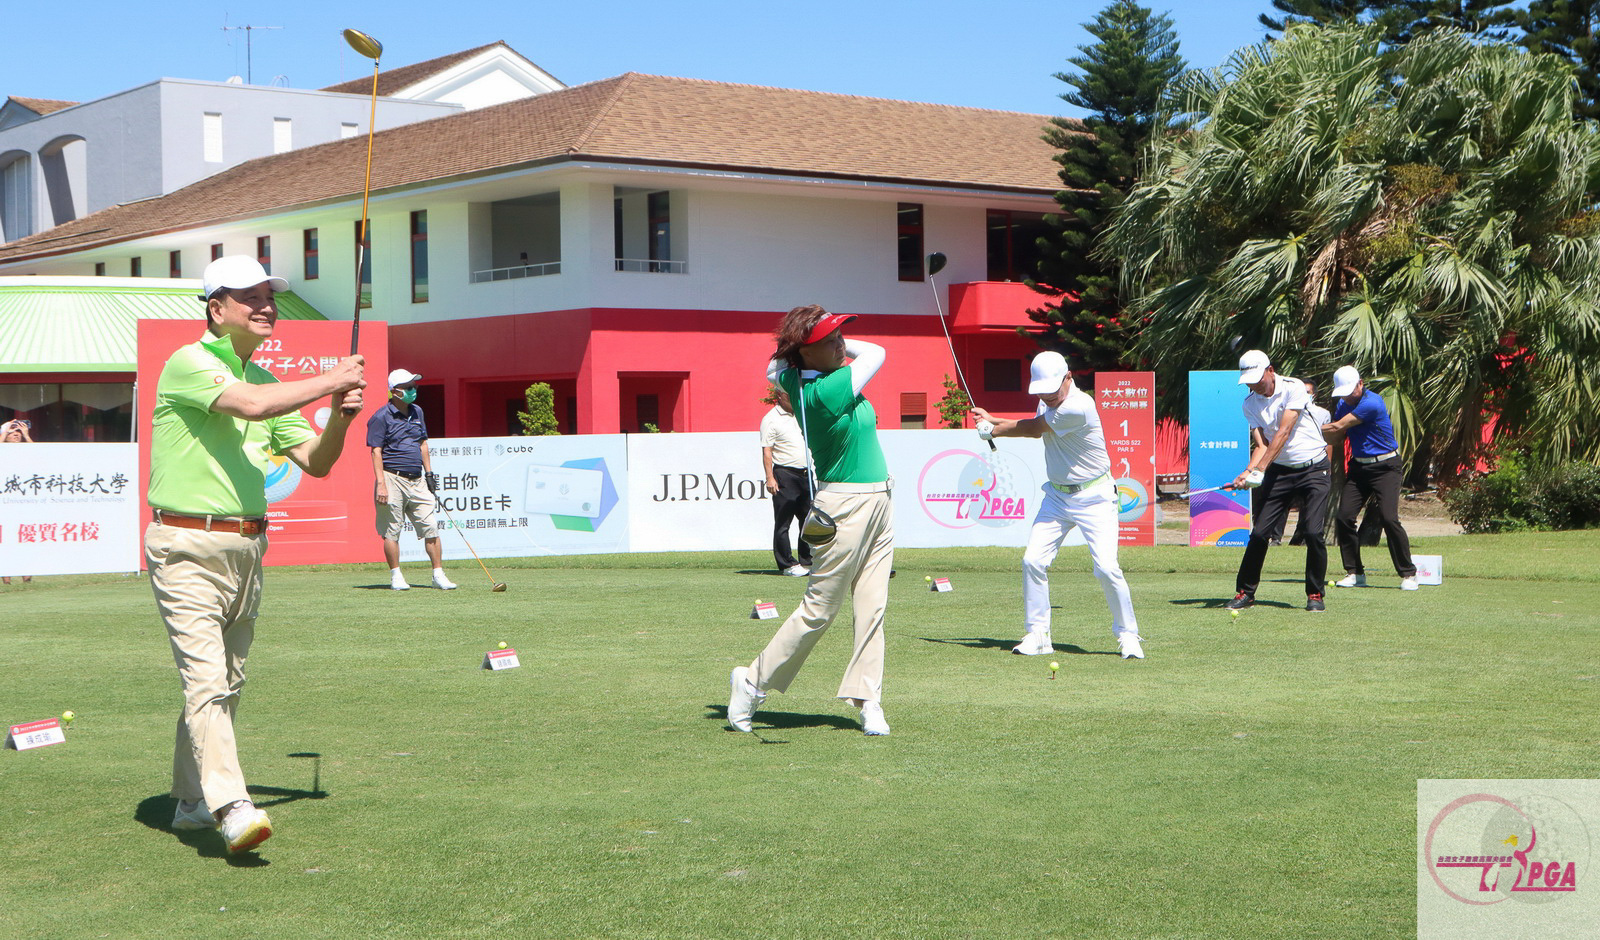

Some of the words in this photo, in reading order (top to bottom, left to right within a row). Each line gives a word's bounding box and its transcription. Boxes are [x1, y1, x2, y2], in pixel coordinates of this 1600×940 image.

[253, 355, 344, 376] 女子公開
[1101, 387, 1149, 398] 大大數位
[1101, 401, 1149, 410] 女子公開賽
[1120, 420, 1128, 437] 1
[506, 444, 534, 454] cube
[1, 472, 129, 496] 城市科技大學
[17, 521, 100, 544] 優質名校
